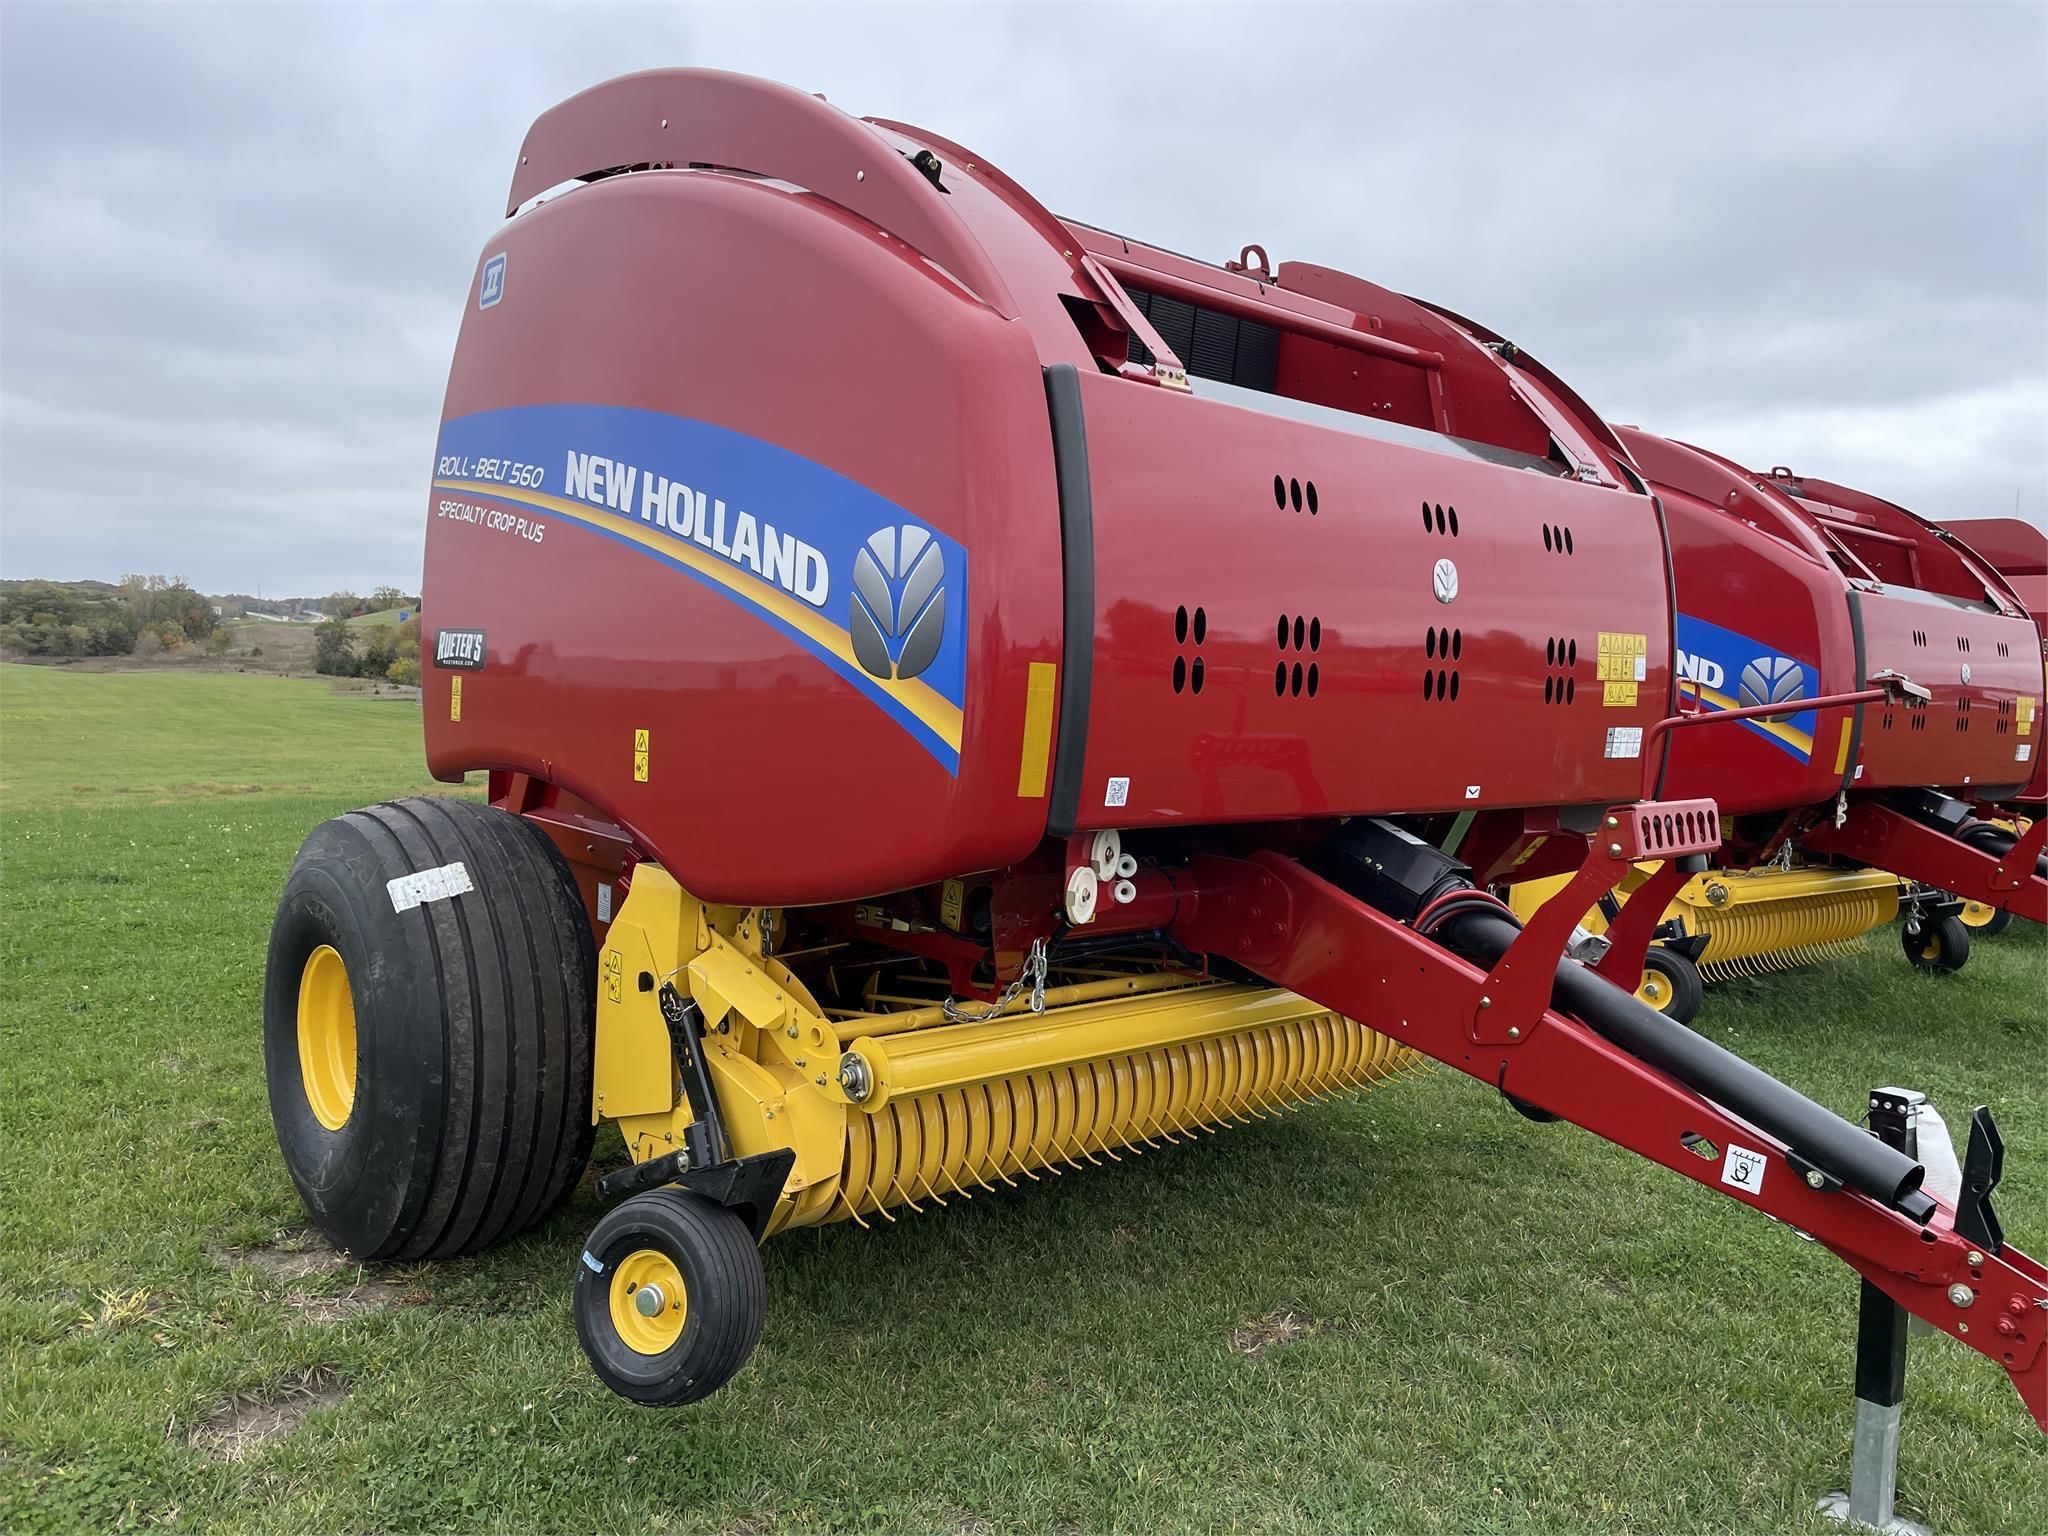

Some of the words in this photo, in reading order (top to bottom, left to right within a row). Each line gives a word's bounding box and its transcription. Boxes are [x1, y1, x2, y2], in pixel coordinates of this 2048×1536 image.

[509, 462, 544, 488] 560
[438, 500, 487, 525] SPECIALTY
[487, 510, 516, 533] CROP
[514, 517, 546, 543] PLUS
[564, 450, 637, 514] NEW
[641, 470, 829, 607] HOLLAND
[437, 631, 483, 662] RUETER'S
